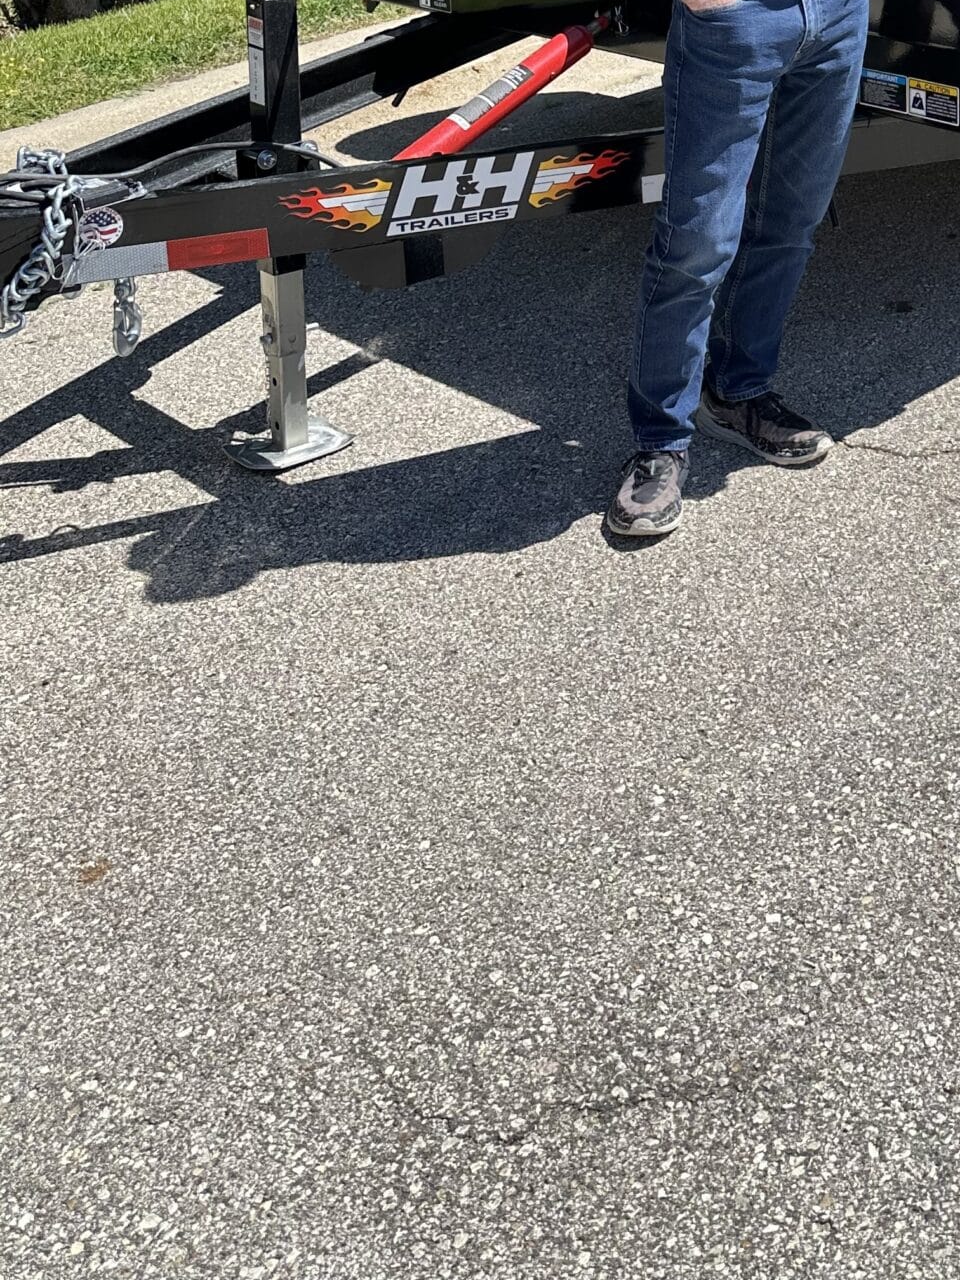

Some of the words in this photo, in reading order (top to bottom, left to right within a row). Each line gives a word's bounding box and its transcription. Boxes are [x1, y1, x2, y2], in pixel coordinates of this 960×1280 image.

[925, 83, 951, 96] CAUTION
[391, 151, 535, 219] H&H
[396, 208, 510, 233] TRAILERS
